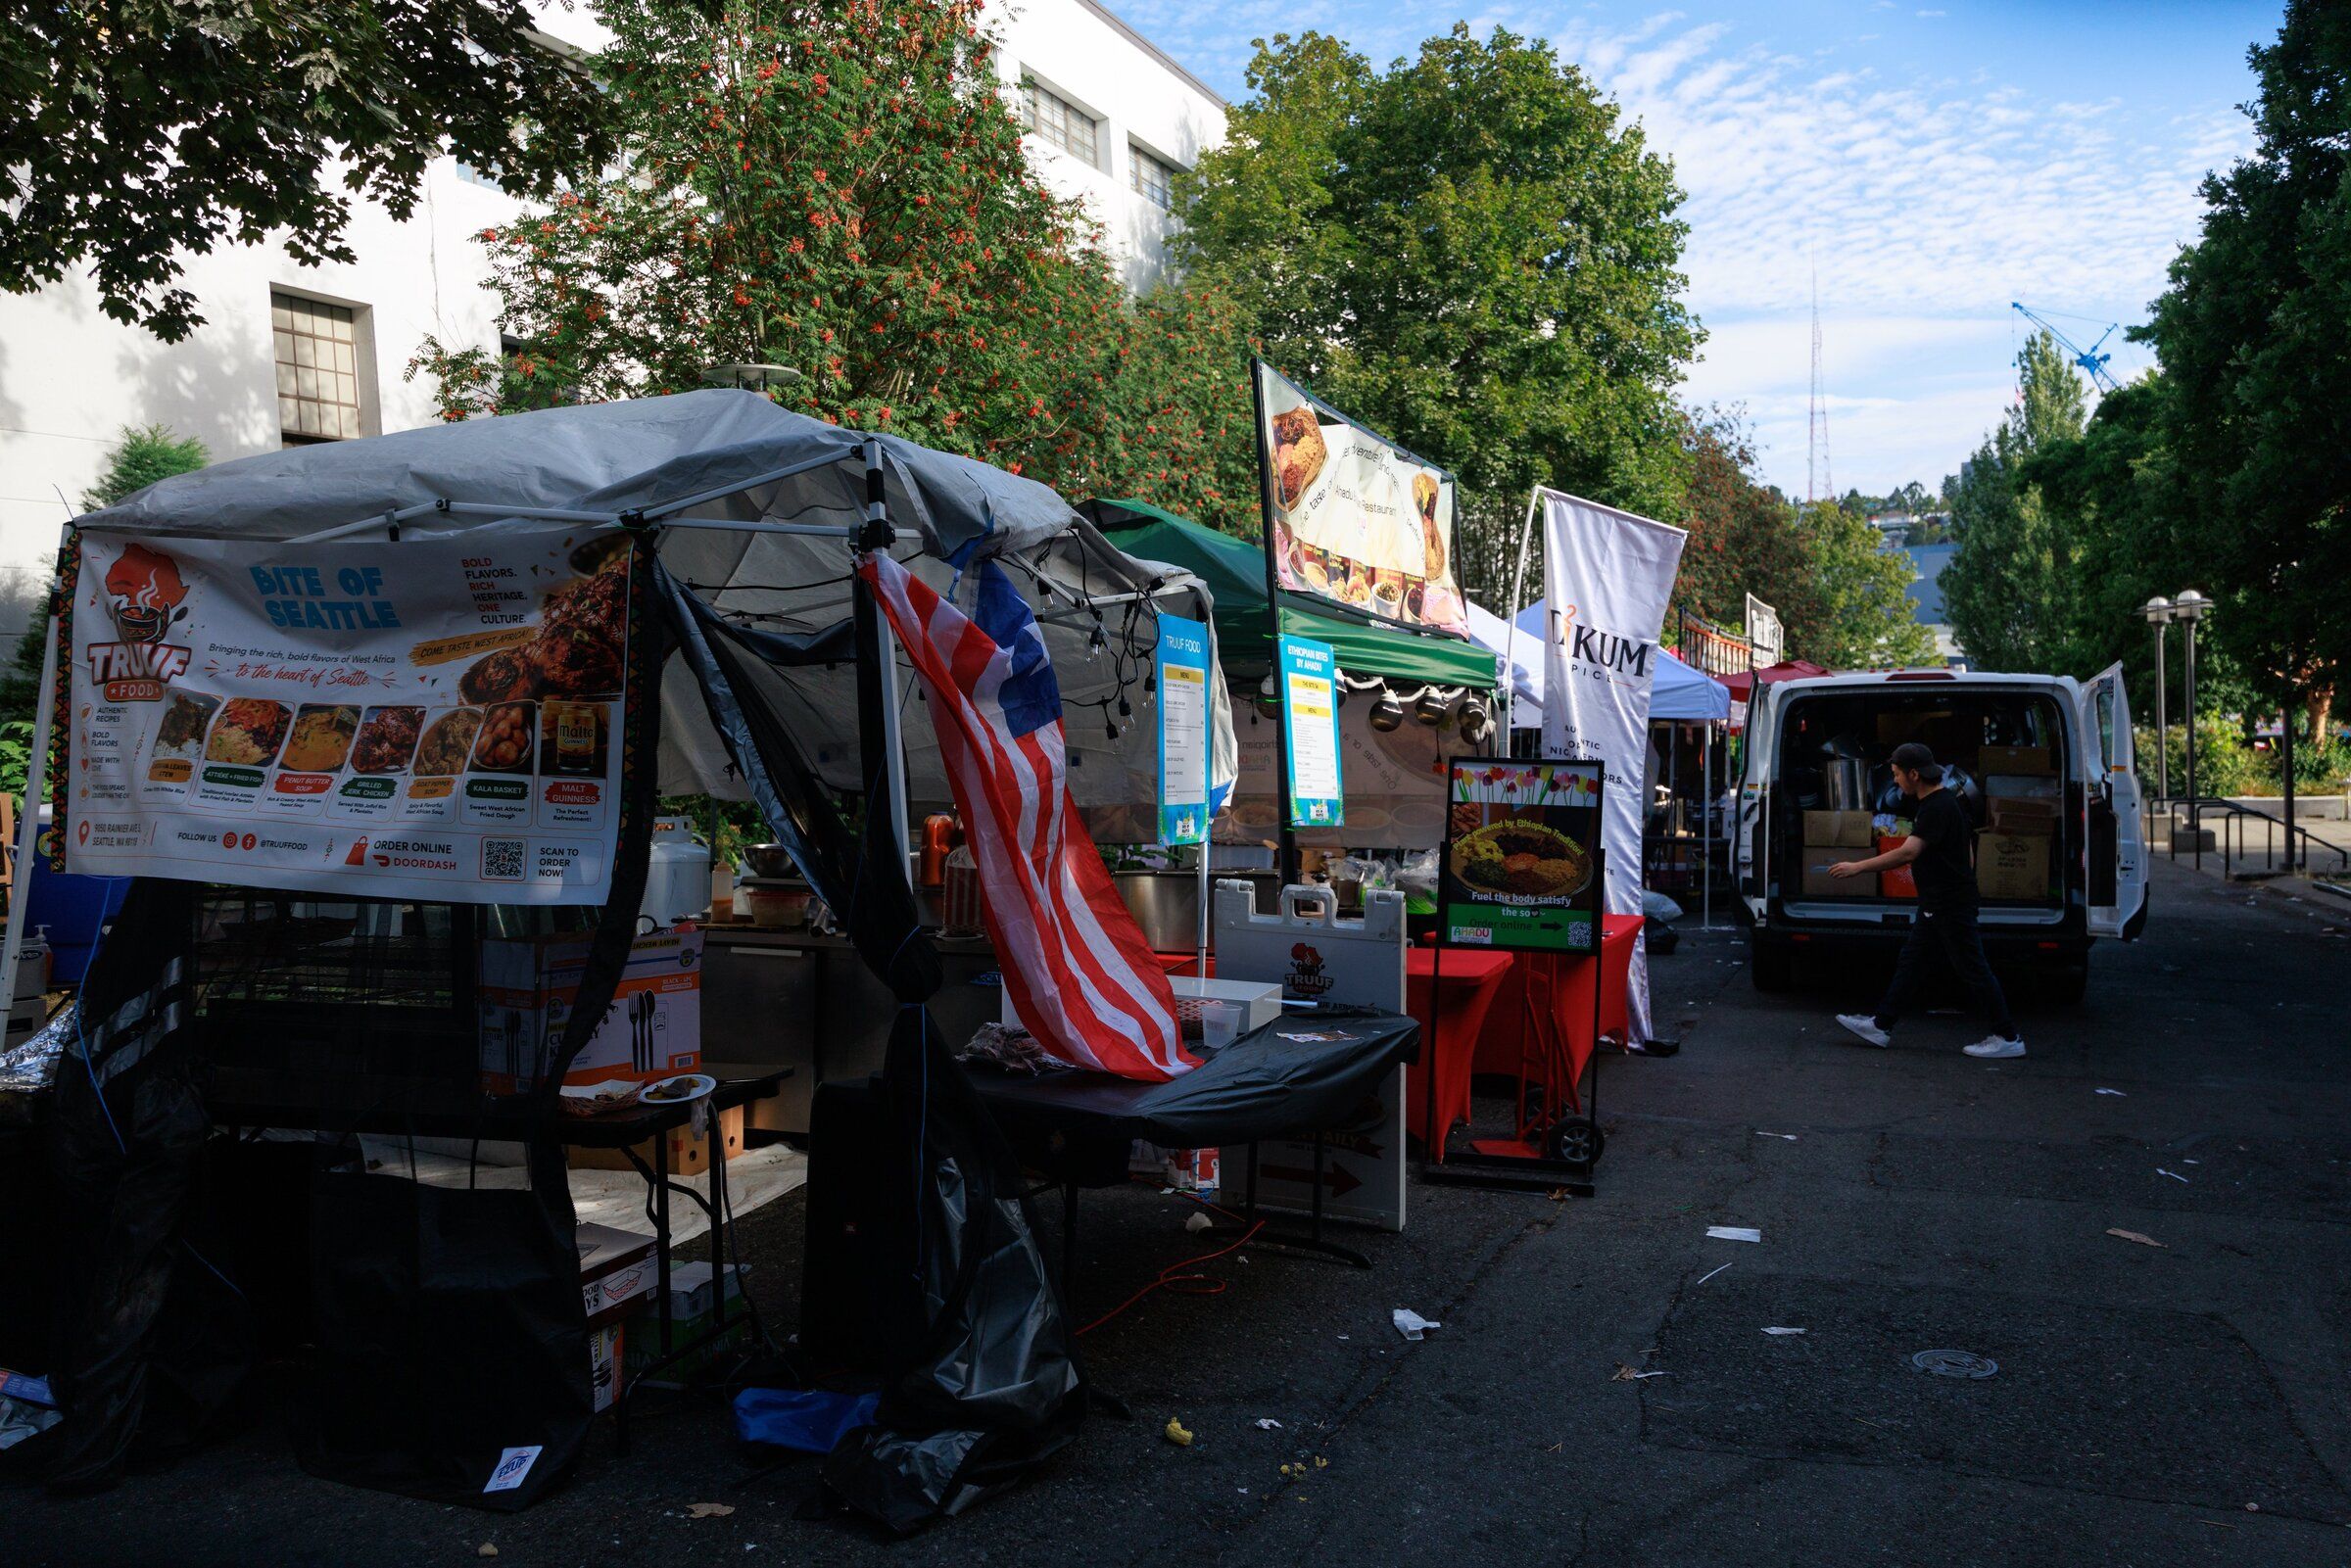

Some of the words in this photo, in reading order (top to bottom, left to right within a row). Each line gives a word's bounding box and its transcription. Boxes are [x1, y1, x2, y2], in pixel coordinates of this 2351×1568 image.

[1310, 489, 1326, 509] taste
[461, 557, 492, 568] BOLD
[465, 568, 517, 579] FLAVORS.
[250, 566, 325, 596] BITE
[338, 567, 383, 596] OF
[468, 582, 496, 591] RICH
[472, 592, 527, 602] HERITAGE.
[477, 603, 501, 612] ONE
[264, 599, 402, 630] SEATTLE
[481, 614, 527, 624] CULTURE.
[420, 645, 444, 658] COME
[448, 641, 471, 652] TASTE
[474, 636, 496, 648] WEST
[498, 628, 529, 644] AFRICA!
[1185, 639, 1201, 653] FOOD
[208, 642, 247, 658] Bringing
[249, 647, 264, 657] the
[266, 649, 285, 660] rich,
[287, 651, 309, 662] bold
[311, 652, 339, 663] flavors
[341, 654, 351, 664] of
[352, 655, 371, 664] West
[372, 655, 396, 664] Africa
[234, 662, 249, 678] to
[250, 662, 273, 680] the
[273, 666, 309, 682] heart
[310, 667, 327, 689] of
[326, 669, 371, 687] Seattle.
[119, 684, 155, 697] FOOD
[495, 785, 522, 794] BASKET
[552, 793, 597, 804] GUINNESS
[1471, 821, 1504, 836] powered
[1516, 819, 1553, 833] Ethiopian
[177, 832, 207, 842] FOLLOW
[208, 833, 216, 842] US
[261, 839, 308, 851] @TRUUFFOOD
[373, 839, 409, 852] ORDER
[411, 841, 453, 854] ONLINE
[540, 847, 565, 856] SCAN
[567, 848, 579, 857] TO
[394, 858, 456, 871] DOORDASH
[540, 858, 570, 867] ORDER
[539, 869, 563, 878] NOW!
[1471, 891, 1493, 901] Fuel
[1494, 892, 1510, 902] the
[1511, 893, 1536, 905] body
[1537, 894, 1572, 907] satisfy
[1501, 907, 1517, 917] the
[1469, 918, 1500, 929] Order
[1500, 920, 1533, 931] online
[1454, 927, 1490, 938] AHADU
[1285, 974, 1333, 989] TRUUF
[582, 1284, 600, 1297] OOD
